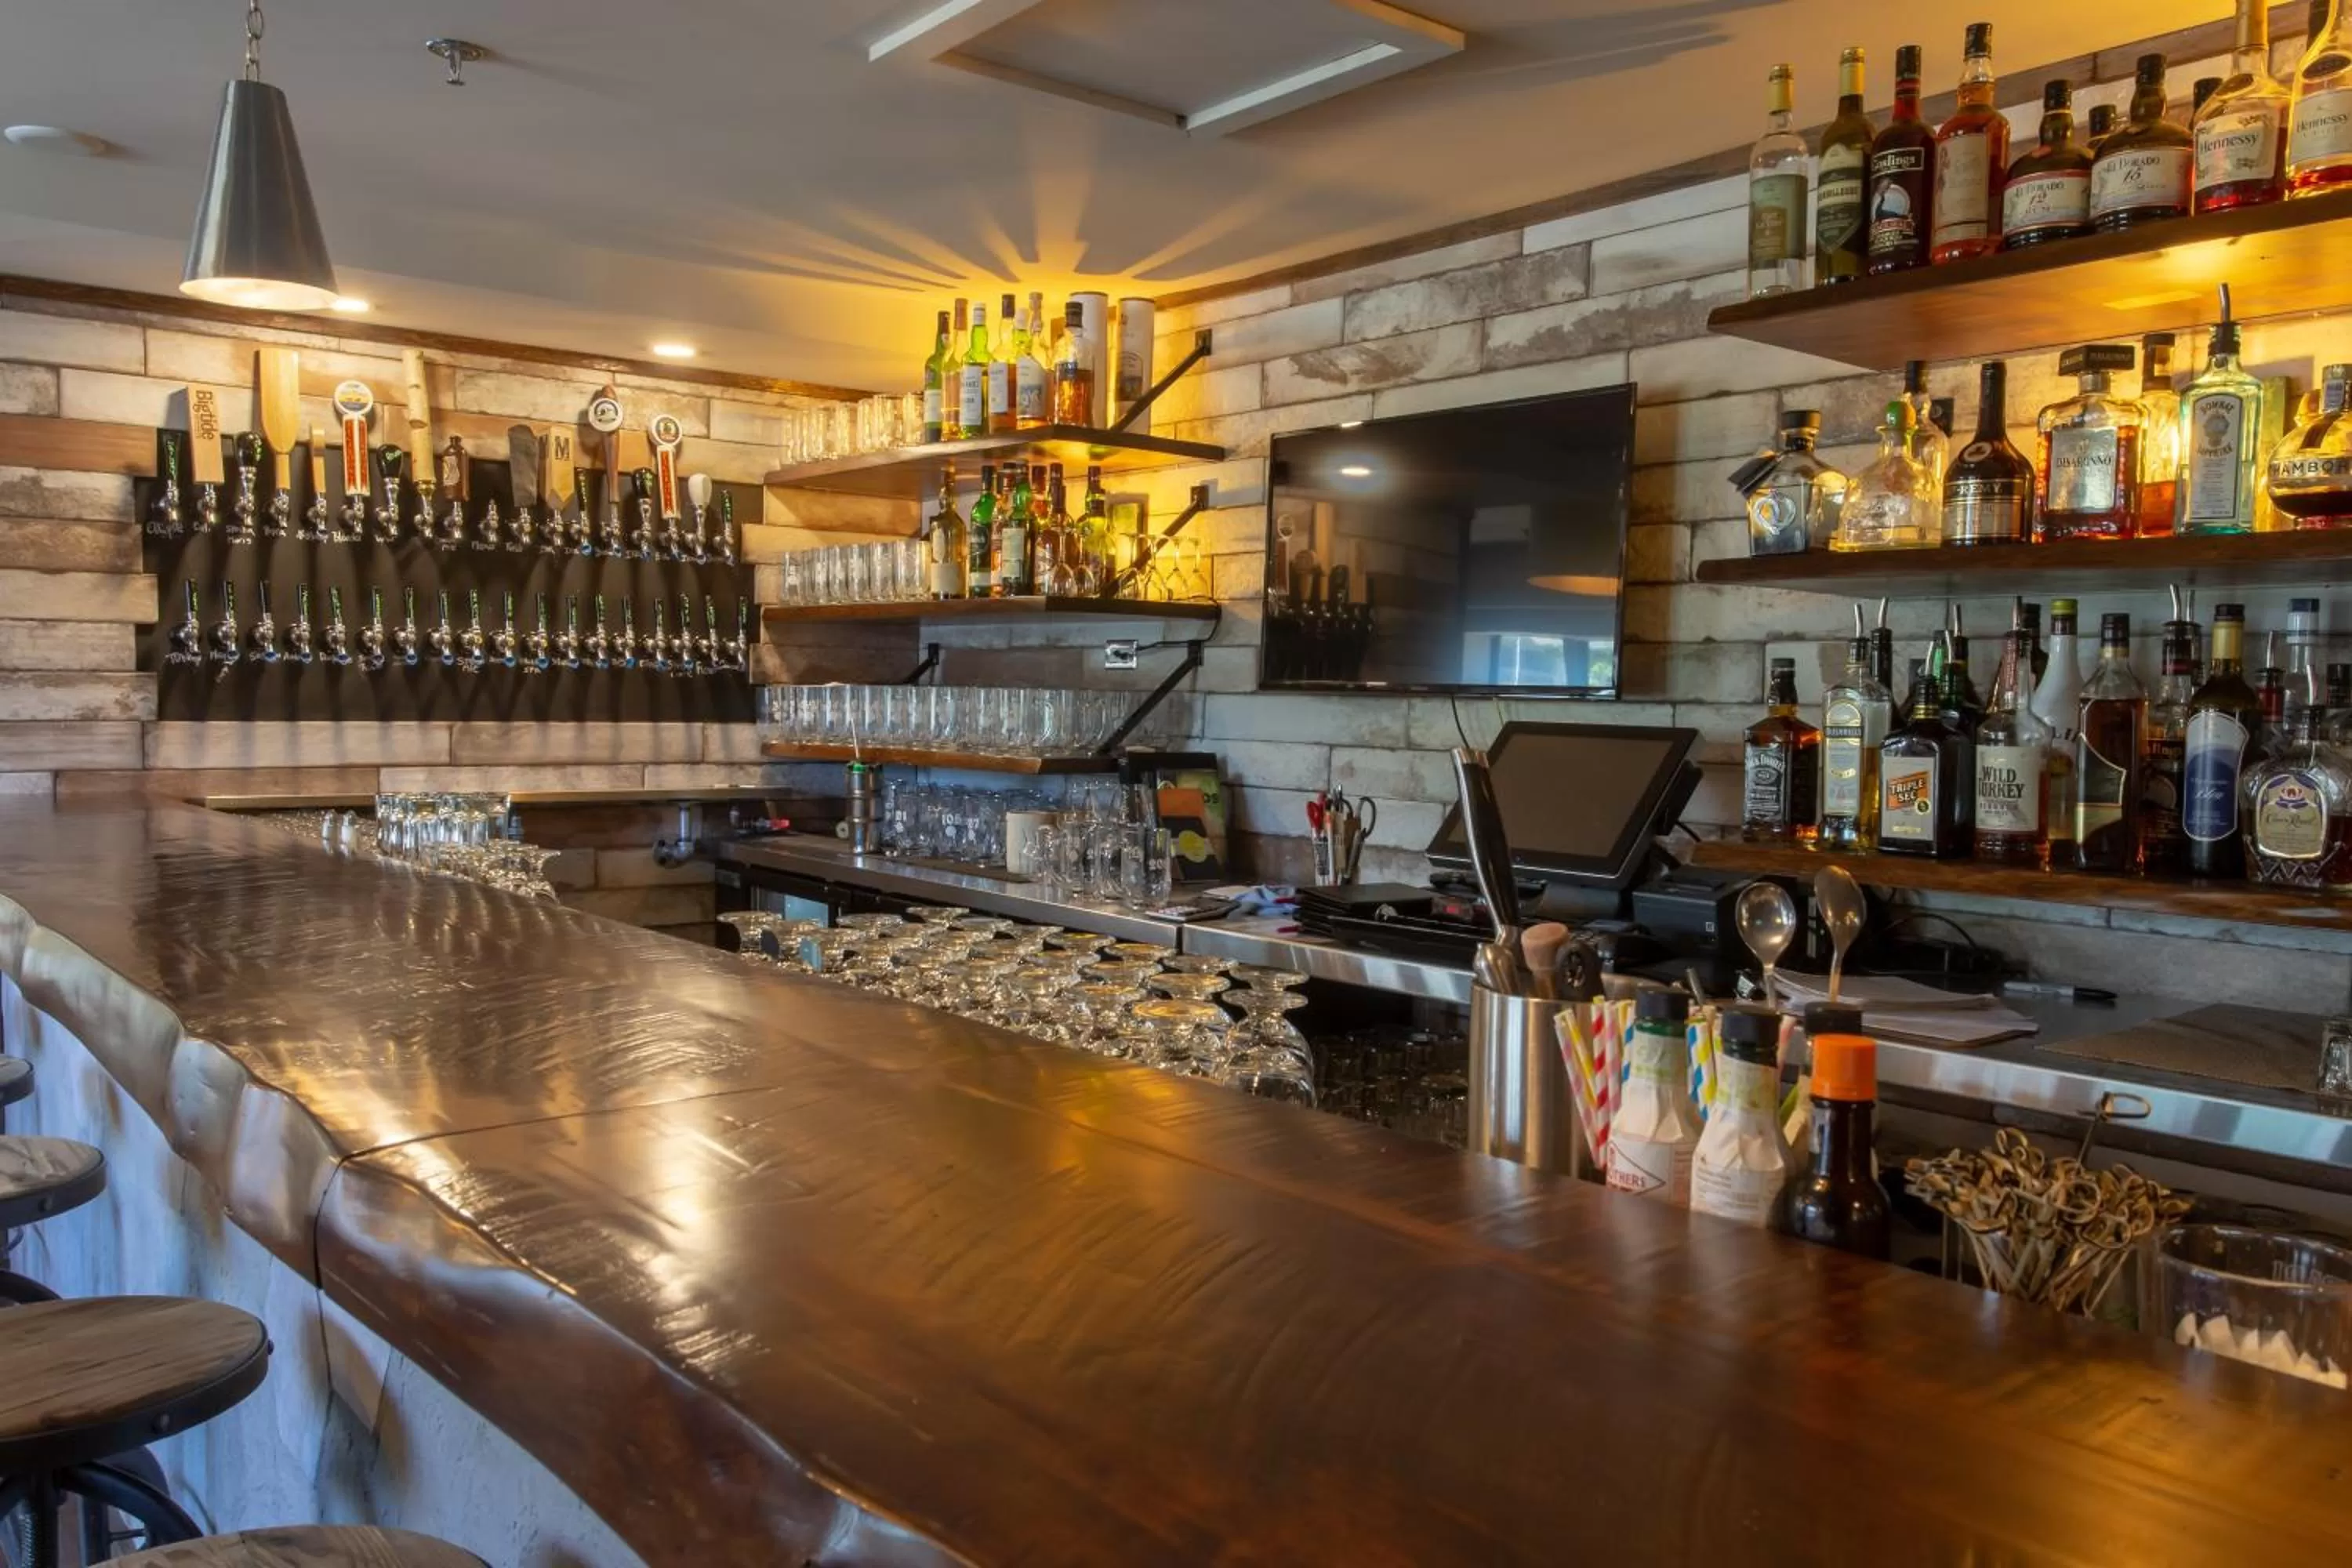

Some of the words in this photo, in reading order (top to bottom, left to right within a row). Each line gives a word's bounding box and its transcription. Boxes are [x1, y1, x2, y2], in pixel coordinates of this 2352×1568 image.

[2296, 114, 2348, 132] Hennessy
[2199, 133, 2258, 152] Hennessy
[2200, 401, 2234, 415] BOMBAY
[554, 435, 570, 461] M
[2270, 460, 2350, 475] HAMBOR
[1981, 765, 2016, 783] WILD
[1890, 778, 1925, 794] TRIPLE
[1978, 778, 2026, 799] TURKEY
[1898, 792, 1917, 803] SEC
